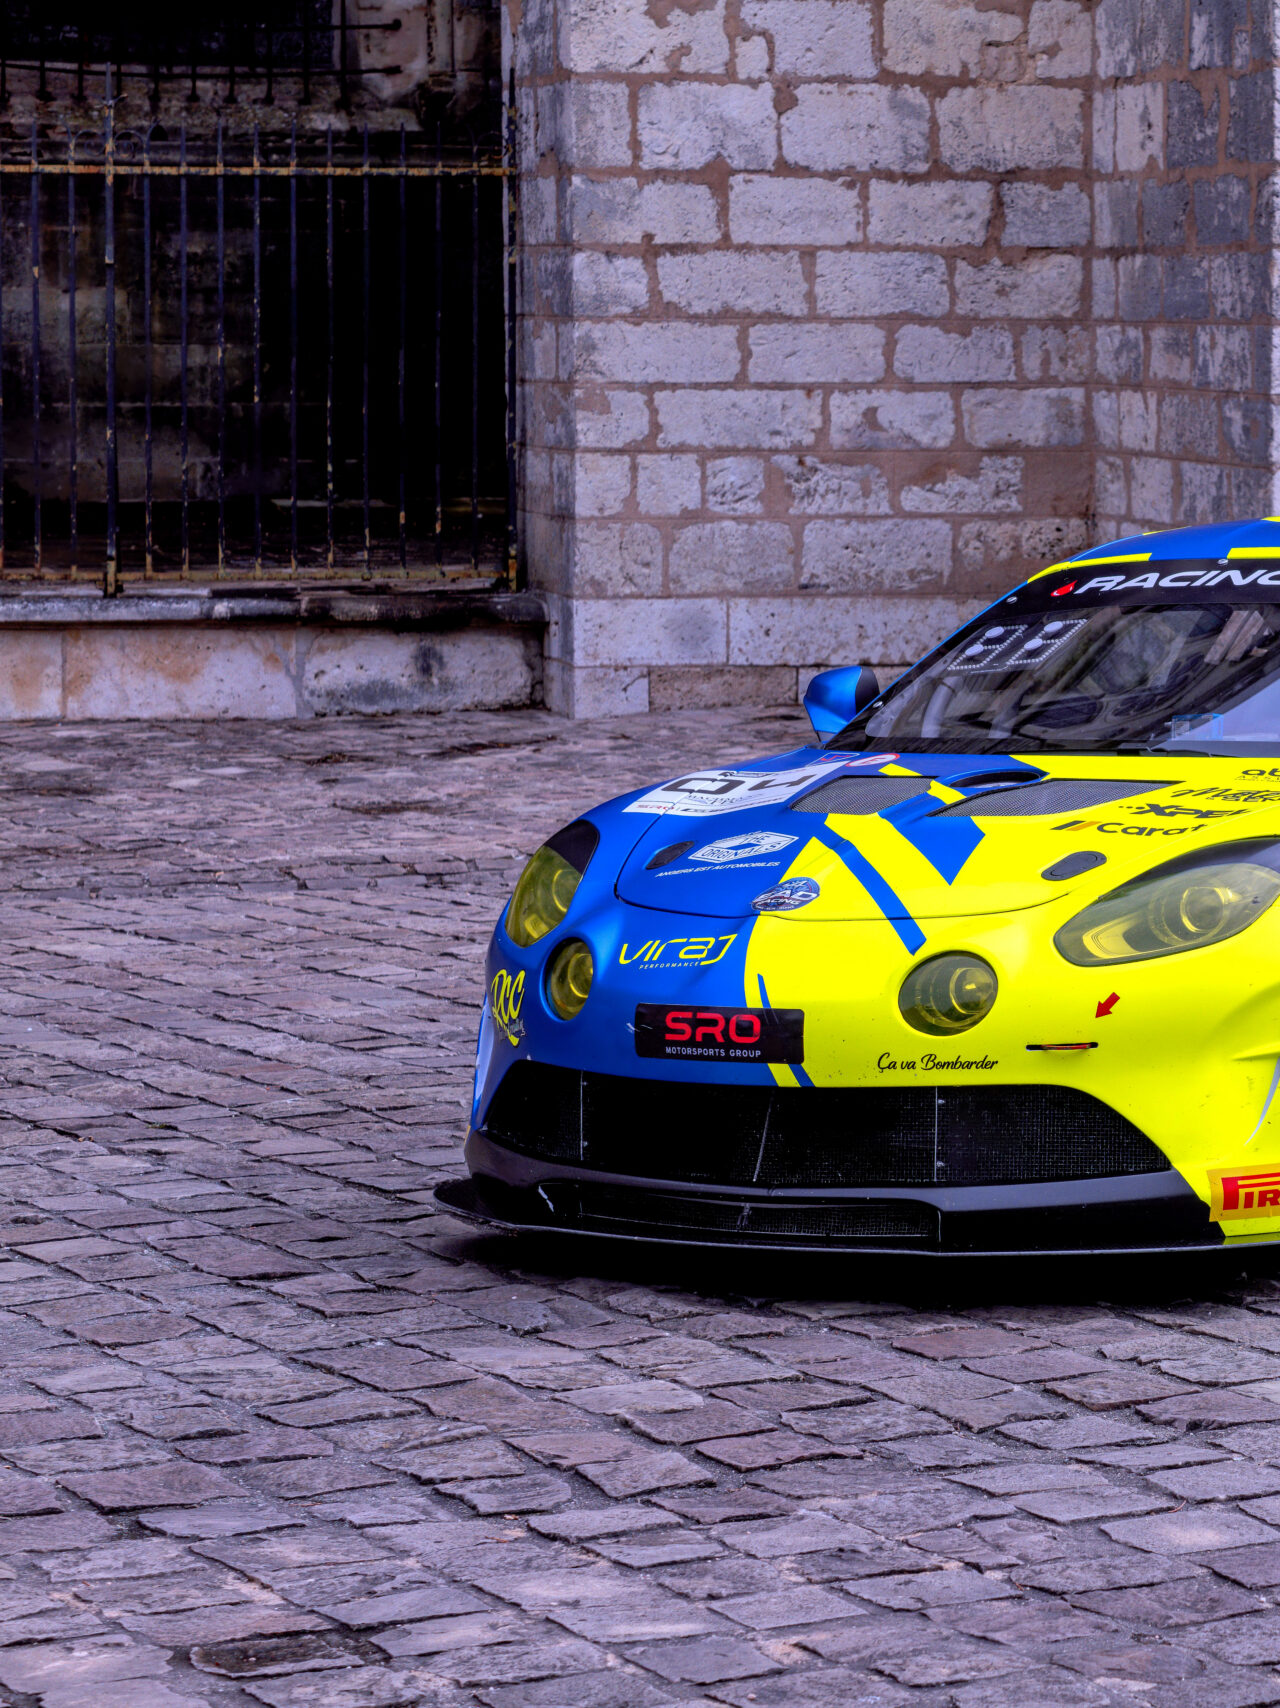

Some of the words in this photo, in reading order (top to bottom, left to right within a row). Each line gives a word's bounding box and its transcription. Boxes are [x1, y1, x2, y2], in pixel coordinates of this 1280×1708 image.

[1096, 822, 1208, 837] Carat
[639, 961, 700, 970] PERFORMANCE
[664, 1011, 762, 1044] SRO
[665, 1046, 726, 1057] MOTORSPORTS
[729, 1048, 761, 1058] GROUP
[877, 1052, 897, 1074] Ça
[900, 1058, 917, 1070] va
[920, 1053, 999, 1071] Bombarder
